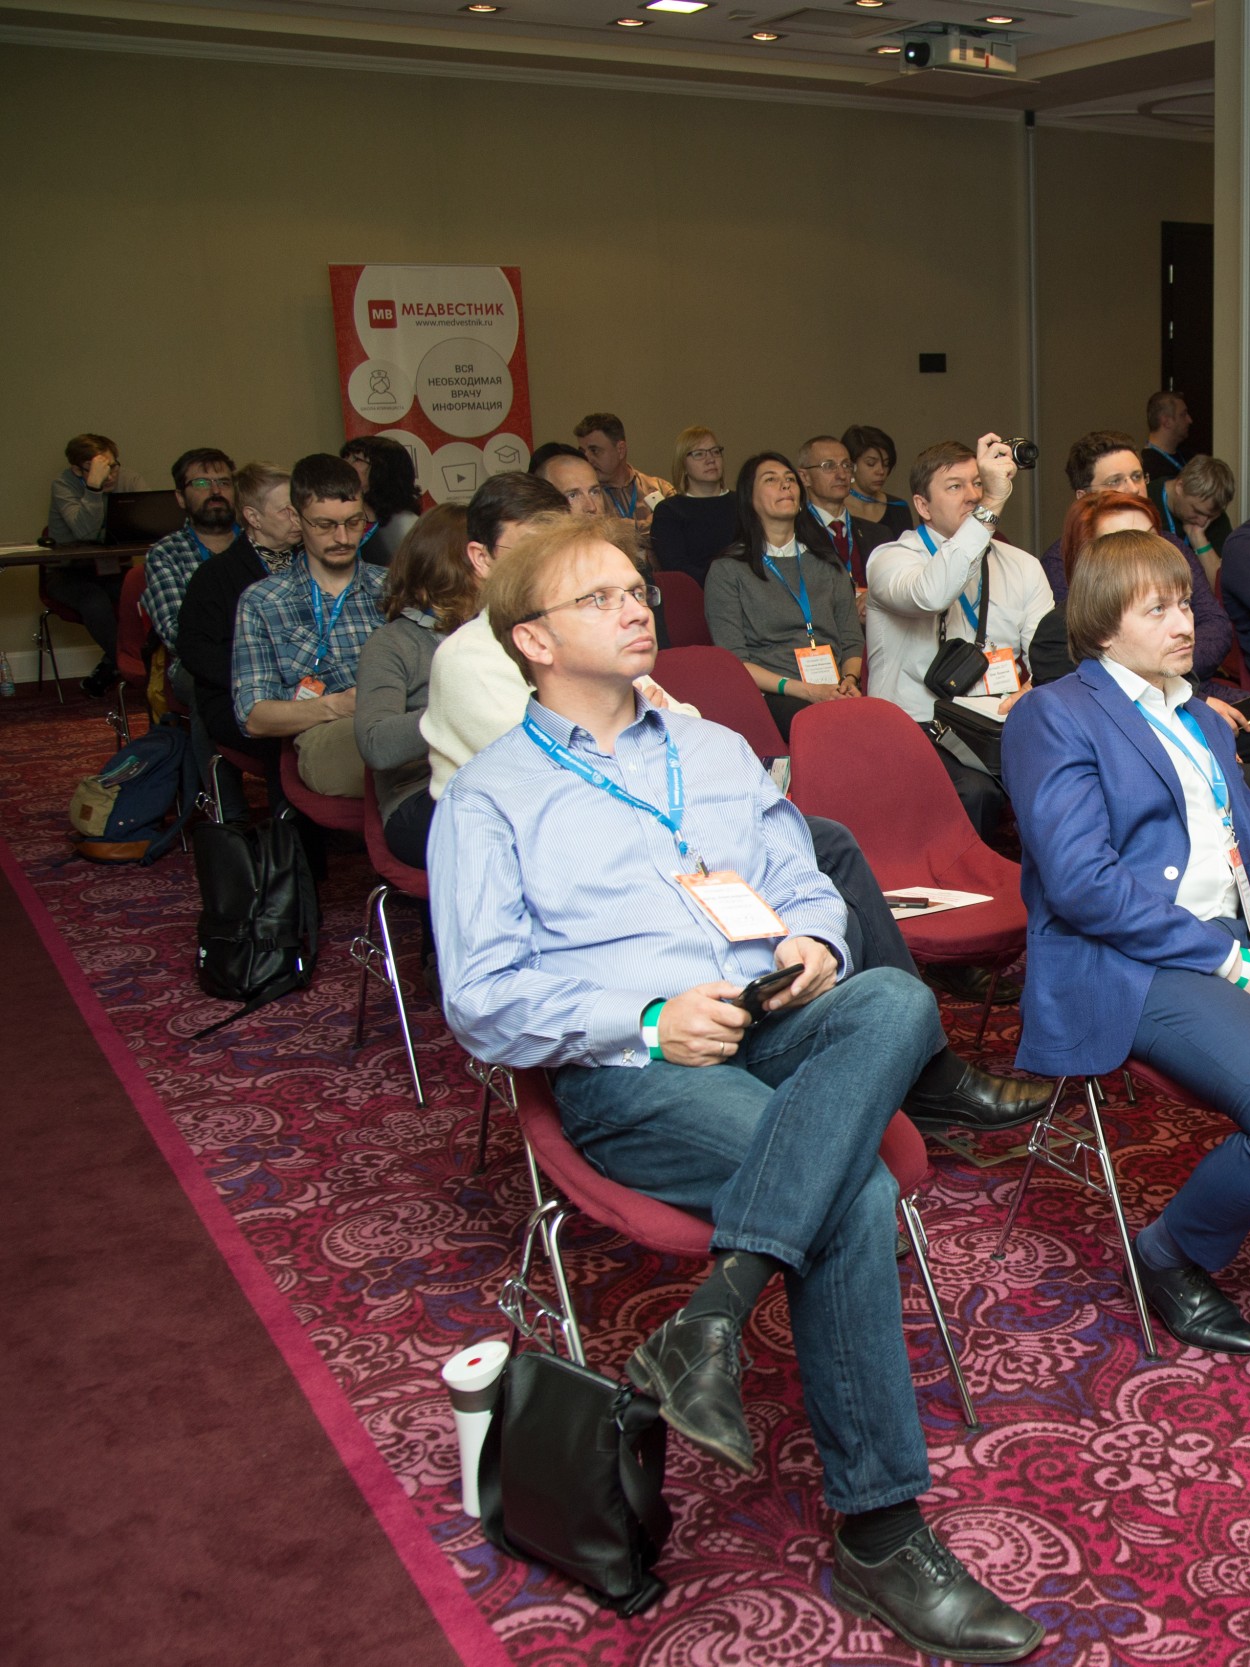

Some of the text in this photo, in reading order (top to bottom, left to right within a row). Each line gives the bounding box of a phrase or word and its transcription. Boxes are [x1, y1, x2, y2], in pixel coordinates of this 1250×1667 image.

[401, 303, 505, 317] МЕДВЕСТНИК
[415, 318, 493, 327] www.medvestnik.ru
[455, 364, 474, 373] ВСЯ
[428, 376, 502, 387] НЕОБХОДИМАЯ
[451, 389, 482, 399] ВРАЧУ
[432, 401, 503, 412] ИНФОРМАЦИЯ
